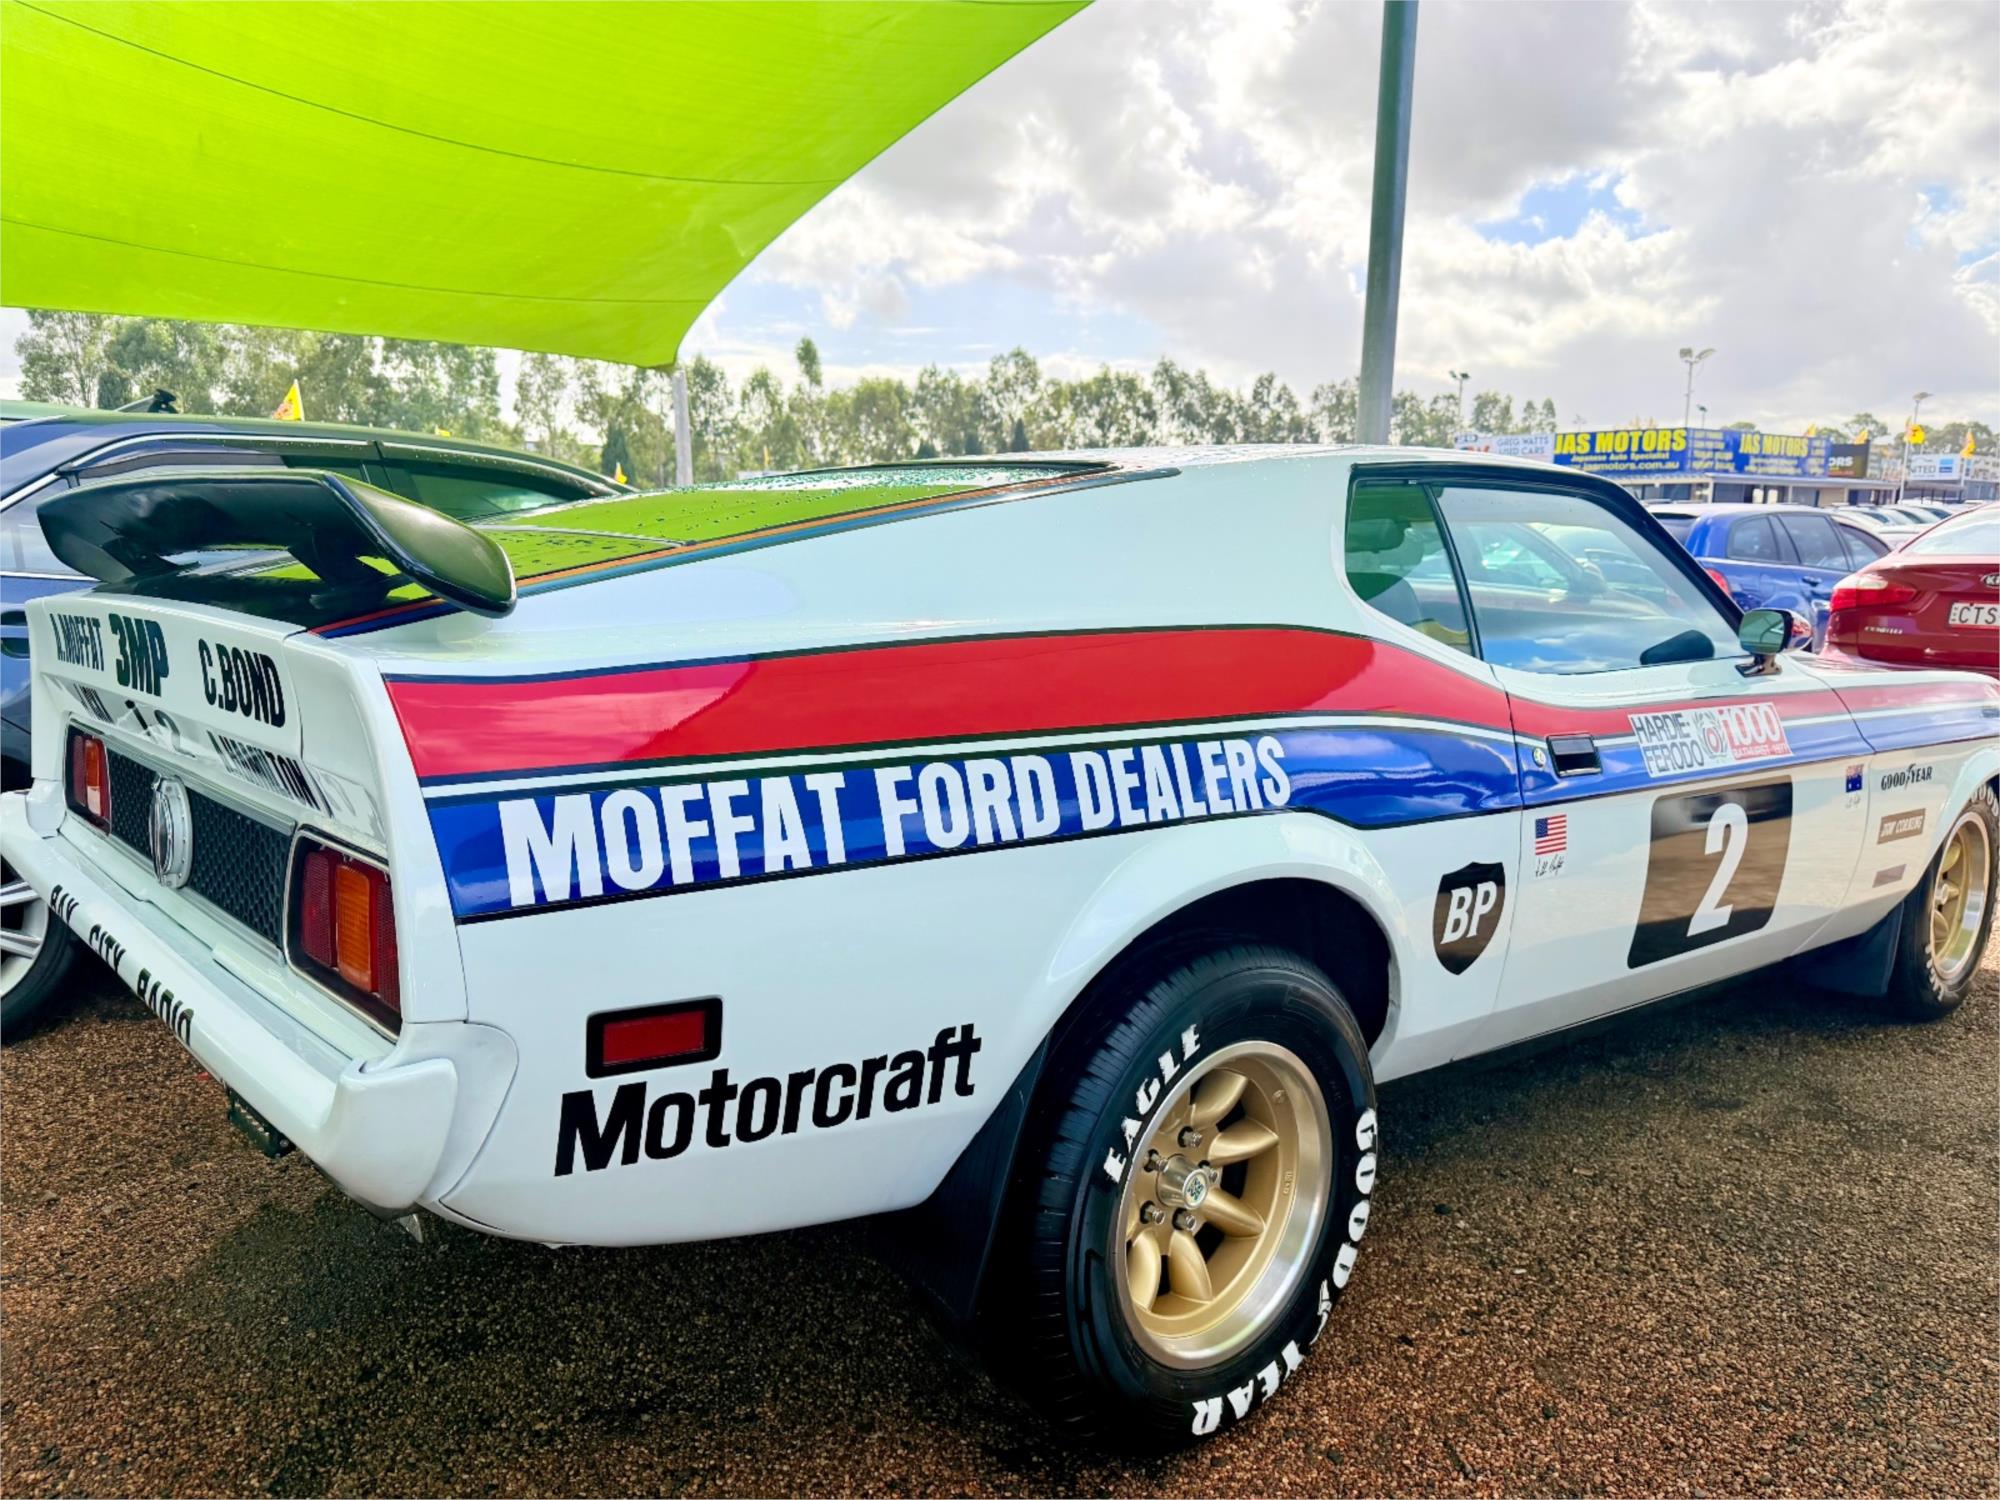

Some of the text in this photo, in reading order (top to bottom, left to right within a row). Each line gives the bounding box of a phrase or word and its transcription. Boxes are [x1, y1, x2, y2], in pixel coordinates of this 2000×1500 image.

[1496, 437, 1520, 446] GREG
[1521, 446, 1545, 454] CARS
[1554, 433, 1591, 455] JAS
[1595, 429, 1687, 453] MOTORS
[1739, 433, 1760, 455] JAS
[1762, 435, 1809, 457] MOTORS
[1959, 606, 1998, 625] CTS
[109, 612, 170, 697] 3MP
[198, 638, 286, 728] C.BOND
[1721, 704, 1781, 747] 1000
[1642, 739, 1705, 774] FERODO
[1881, 763, 1933, 790] GOODYEAR
[498, 735, 1292, 908] MOFFAT FORD DEALERS
[1687, 803, 1749, 938] 2
[1441, 880, 1498, 946] BP
[553, 1023, 982, 1177] Motorcraft
[1103, 1023, 1201, 1184] EAGLE
